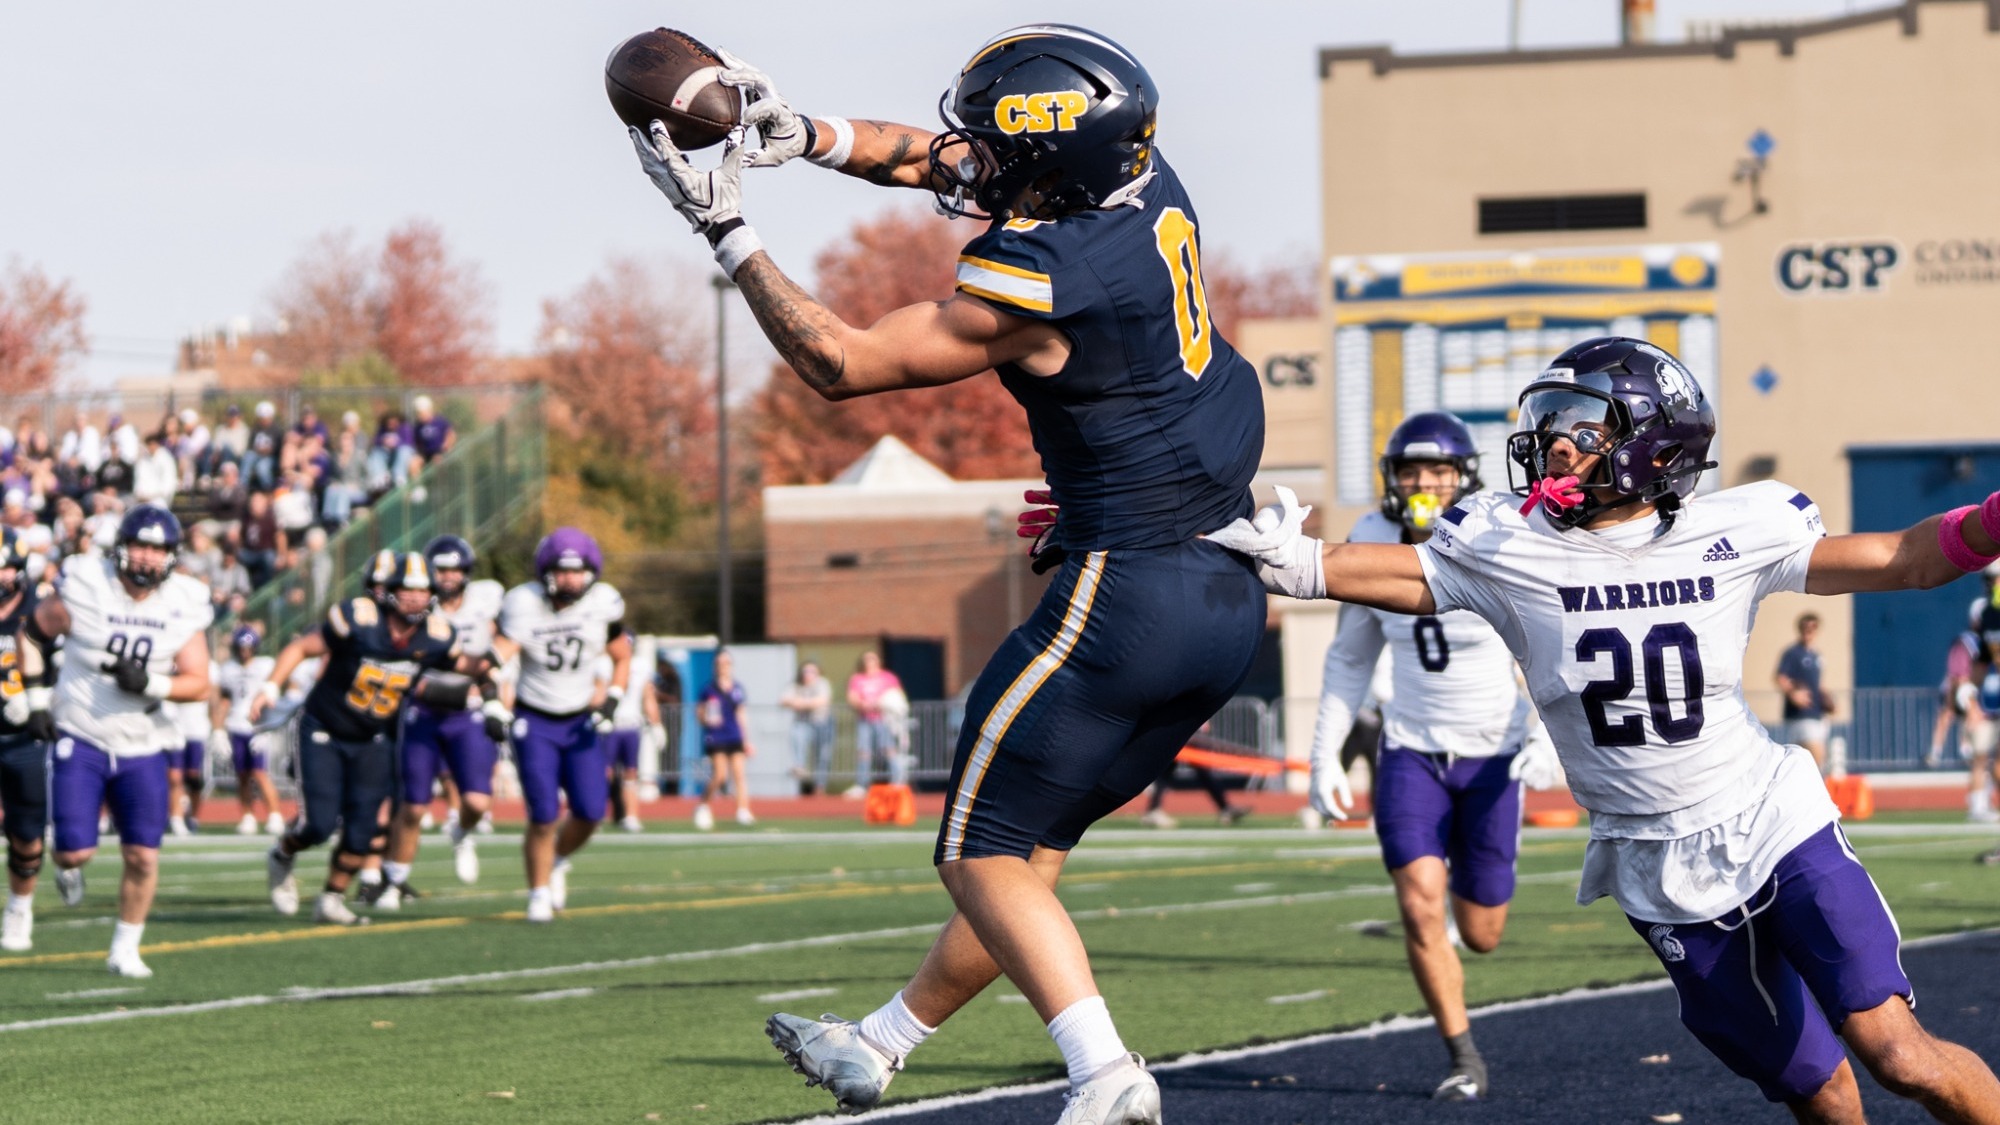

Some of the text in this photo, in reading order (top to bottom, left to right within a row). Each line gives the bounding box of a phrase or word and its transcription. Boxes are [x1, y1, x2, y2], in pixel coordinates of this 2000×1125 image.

[995, 90, 1088, 134] CSP
[1780, 243, 1898, 291] CSP
[1153, 206, 1212, 381] 0
[1702, 551, 1740, 562] adidas
[1557, 576, 1715, 612] WARRIORS
[546, 636, 584, 672] 57
[1413, 616, 1450, 672] 0
[347, 662, 413, 718] 55
[1575, 622, 1704, 747] 20
